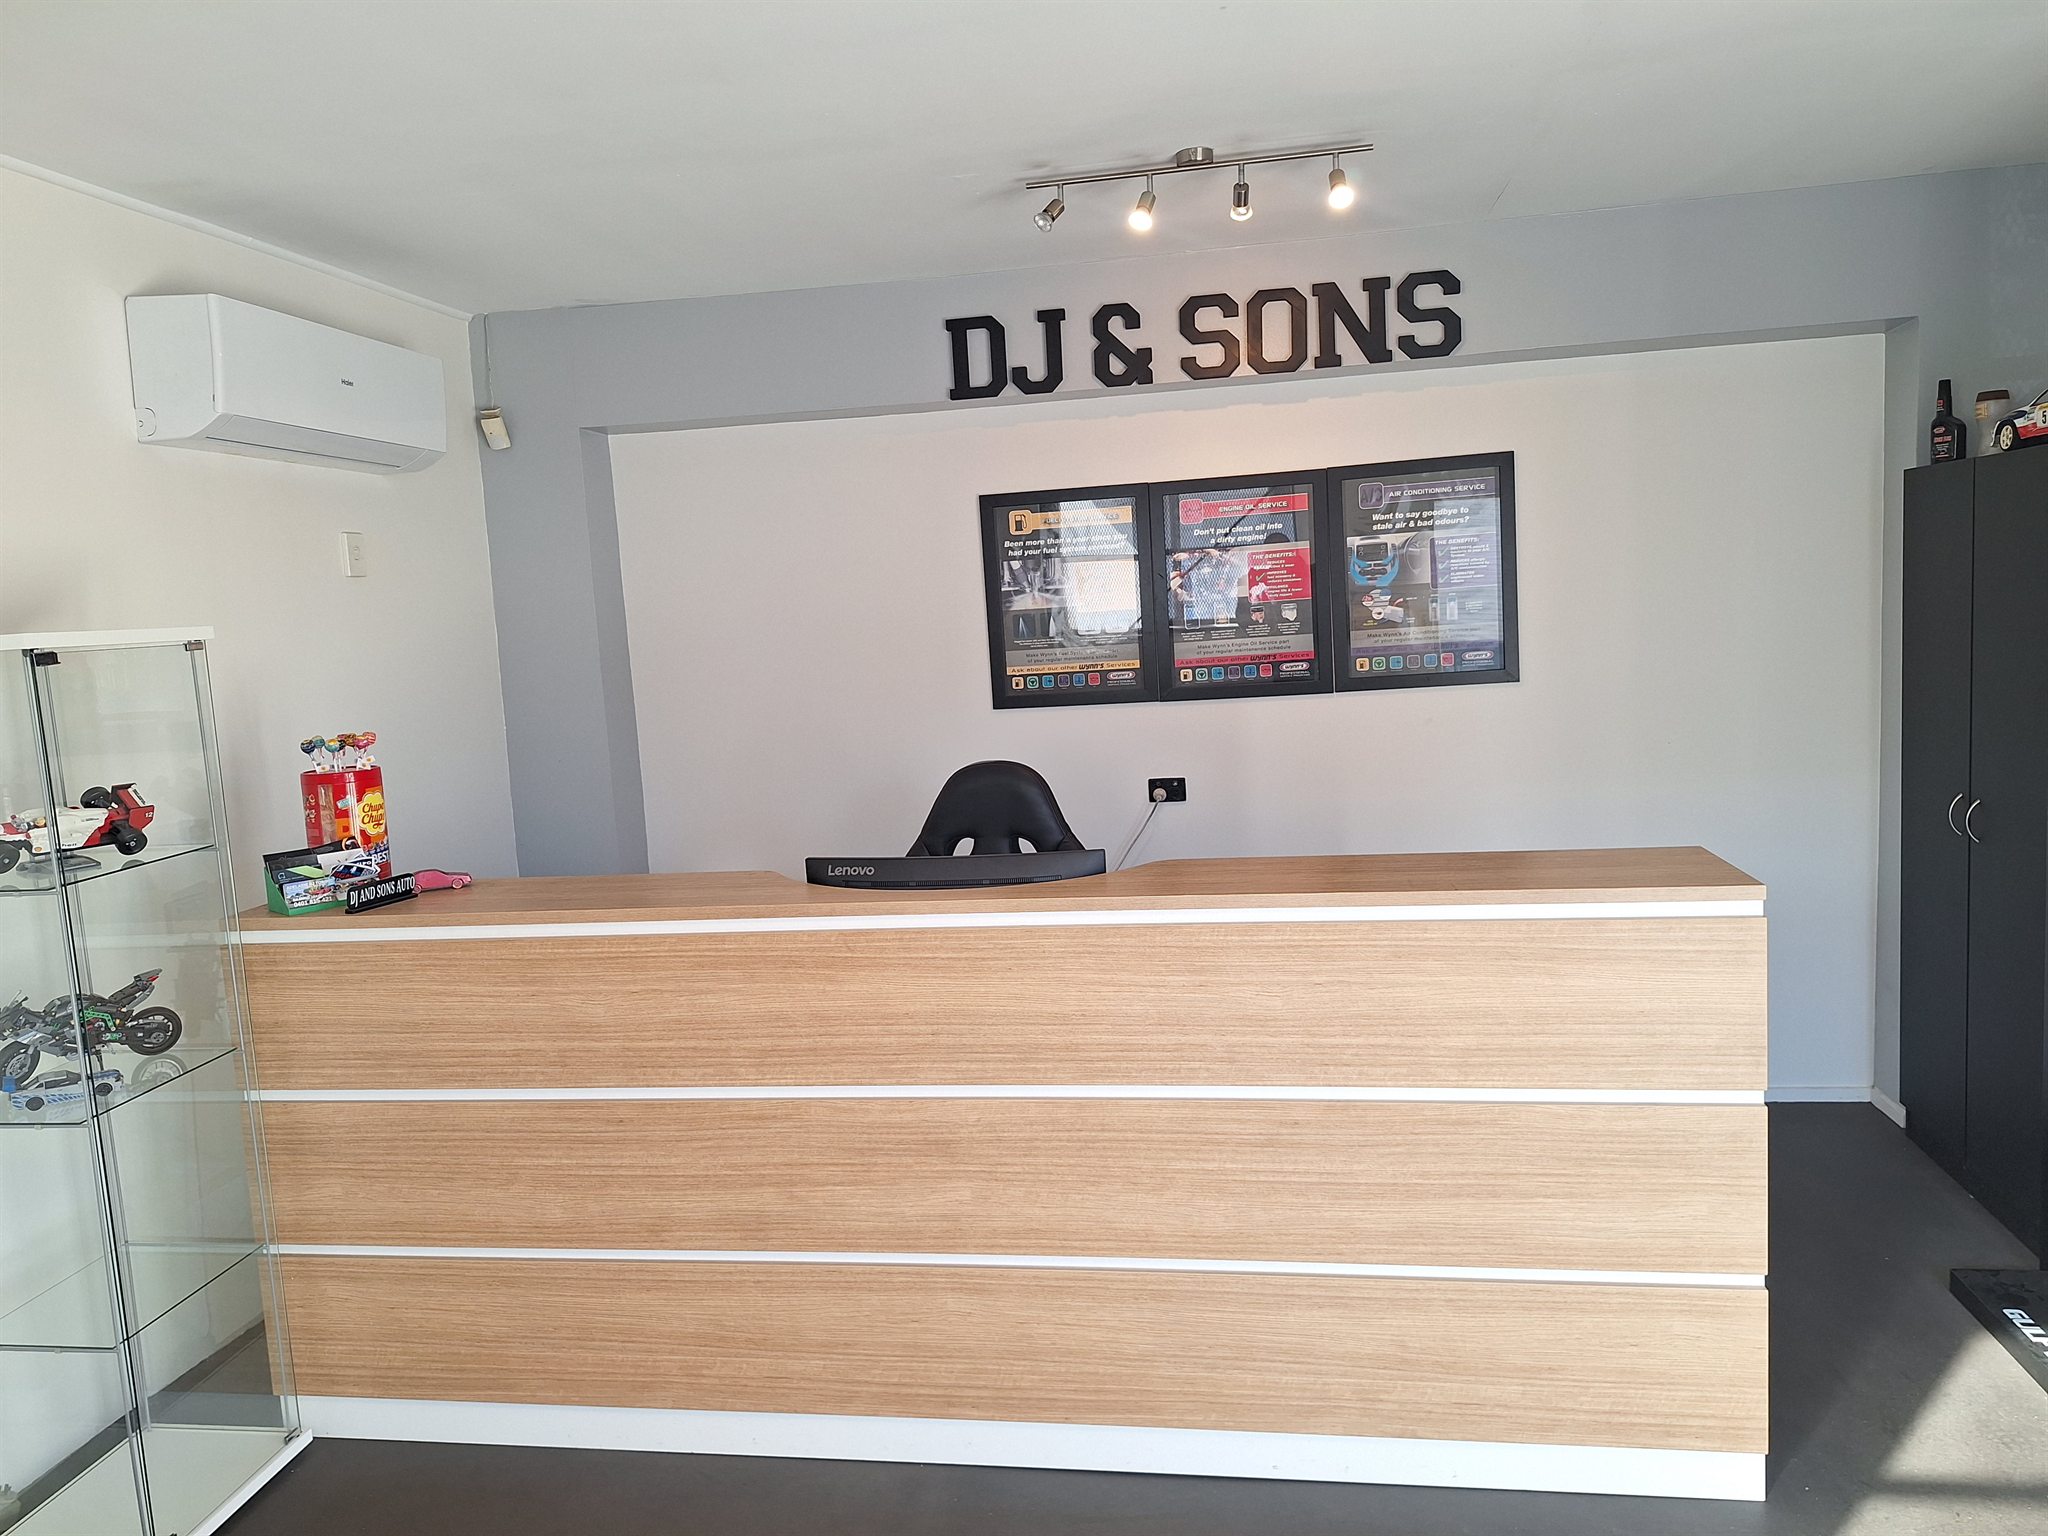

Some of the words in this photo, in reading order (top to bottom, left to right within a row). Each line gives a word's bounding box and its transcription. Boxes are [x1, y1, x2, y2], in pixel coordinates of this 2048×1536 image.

[945, 307, 1066, 400] DJ
[1092, 302, 1153, 388] &
[1179, 269, 1462, 381] SONS
[2041, 410, 2047, 424] 5
[1389, 490, 1401, 498] AIR
[1403, 486, 1452, 497] CONDITIONING
[1454, 483, 1486, 492] SERVICE
[1219, 505, 1243, 513] ENGINE
[1258, 501, 1288, 509] SERVICE
[1372, 512, 1394, 521] Want
[1395, 511, 1404, 519] to
[1405, 510, 1420, 519] say
[1422, 506, 1458, 518] goodbye
[1460, 506, 1470, 514] to
[1193, 527, 1215, 536] Don't
[1216, 526, 1230, 535] put
[1231, 524, 1254, 533] clean
[1255, 523, 1266, 531] oil
[1267, 522, 1283, 531] into
[1372, 522, 1393, 530] stale
[1395, 520, 1407, 529] air
[1417, 518, 1433, 527] bad
[1435, 515, 1470, 526] odours?
[1004, 540, 1024, 548] Been
[1217, 535, 1235, 544] dirty
[1237, 533, 1267, 543] engine!
[1024, 549, 1042, 557] your
[1043, 546, 1058, 554] fuel
[827, 864, 875, 876] Lenovo
[349, 889, 359, 907] DJ
[360, 885, 375, 903] AND
[376, 880, 396, 898] SONS
[396, 875, 416, 893] AUTO
